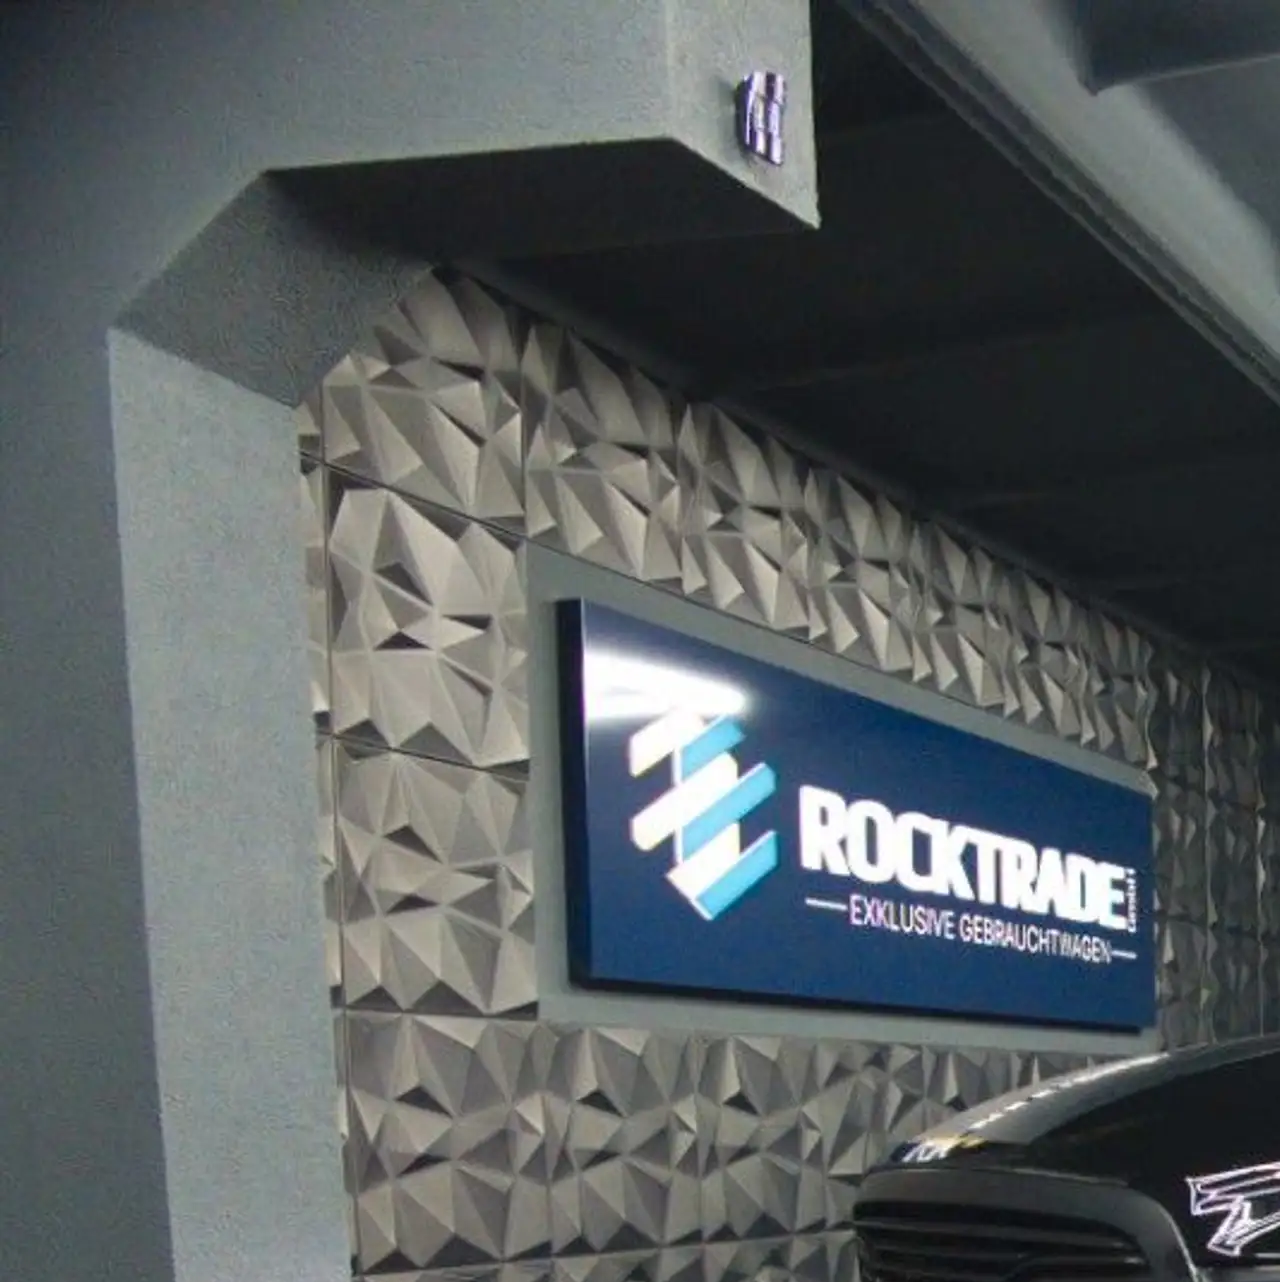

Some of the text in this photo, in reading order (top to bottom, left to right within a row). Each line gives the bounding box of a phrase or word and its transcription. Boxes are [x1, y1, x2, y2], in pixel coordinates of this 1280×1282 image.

[799, 785, 1127, 930] ROCKTRADE
[849, 895, 1112, 964] EXKLUSIVE GEBRAUCHTWAGEN
